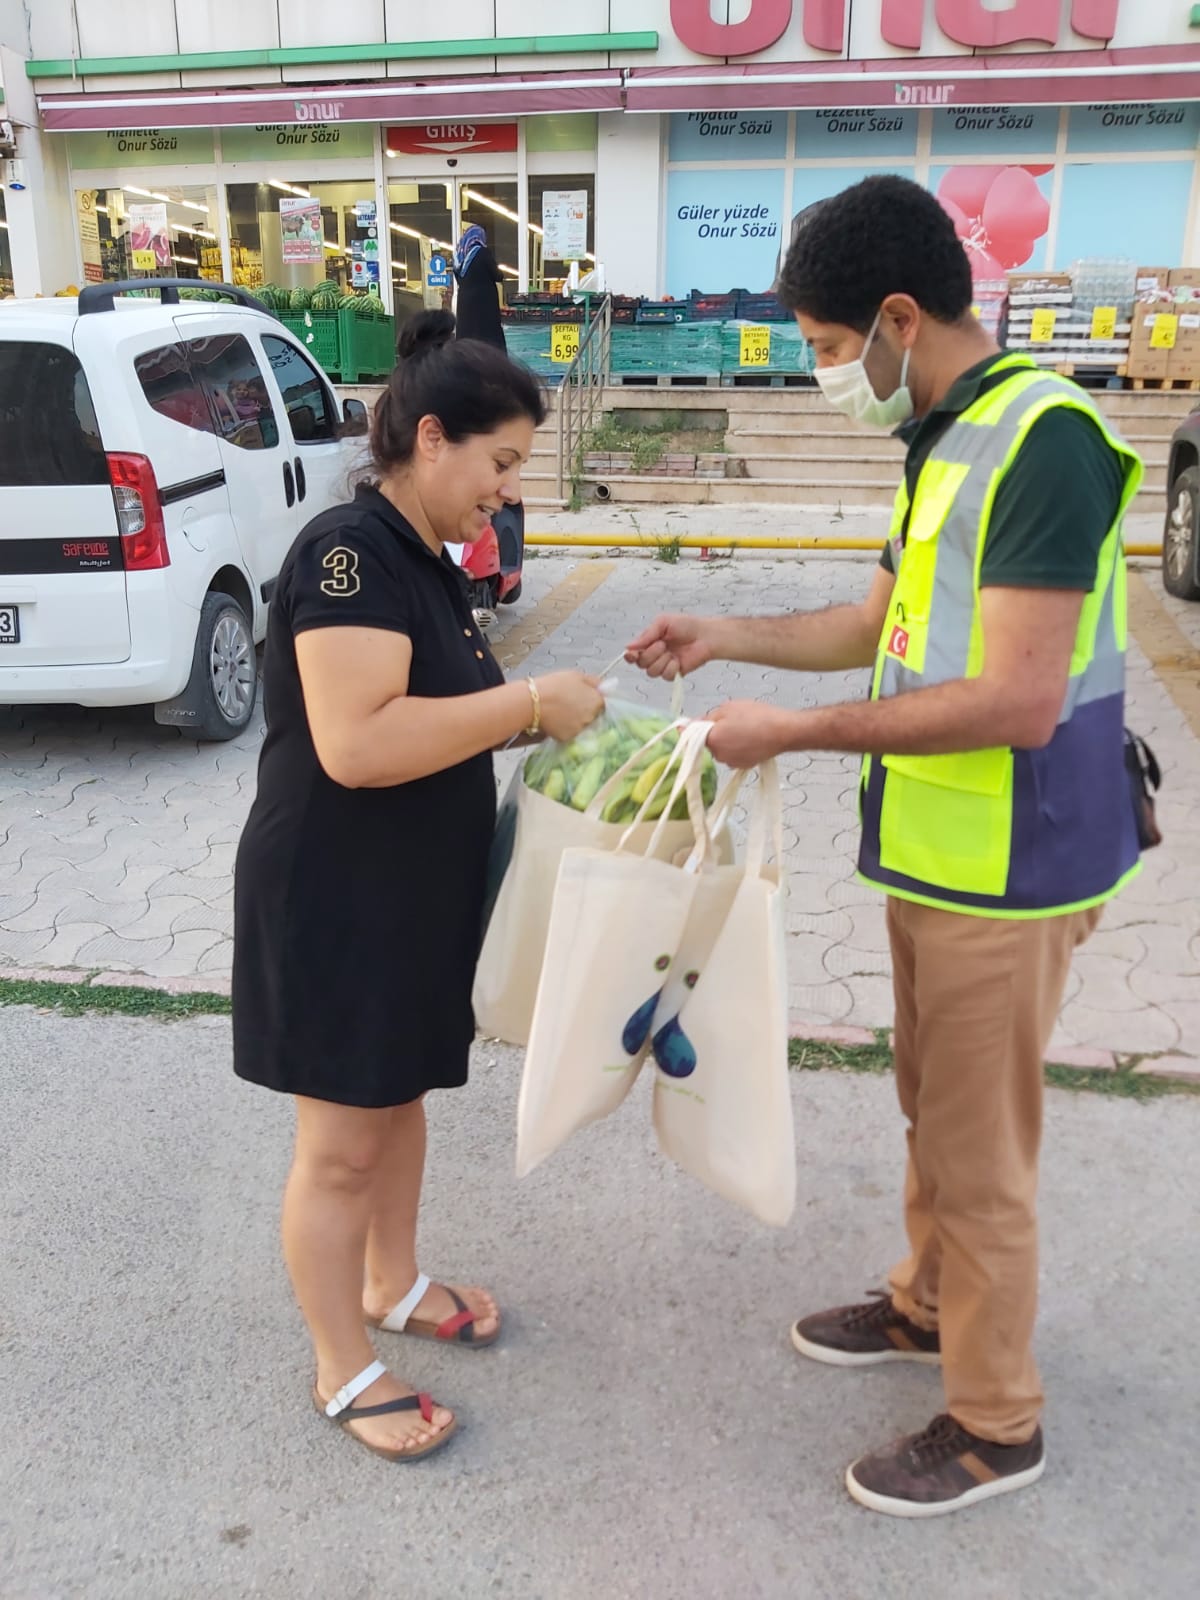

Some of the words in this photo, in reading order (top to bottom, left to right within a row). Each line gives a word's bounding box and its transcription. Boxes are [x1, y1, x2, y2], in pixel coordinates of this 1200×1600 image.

[895, 83, 955, 104] onur
[295, 101, 344, 120] onur
[1102, 112, 1142, 127] Onur
[1146, 108, 1185, 125] Sözü
[699, 122, 736, 136] Onur
[739, 120, 772, 135] Sözü
[827, 119, 864, 133] Onur
[868, 116, 903, 132] Sözü
[955, 116, 994, 130] Onur
[997, 114, 1034, 129] Sözü
[118, 139, 147, 152] Onur
[150, 137, 177, 150] Sözü
[276, 132, 308, 145] Onur
[310, 129, 340, 143] Sözü
[678, 204, 720, 220] Güler
[724, 204, 769, 222] yüzde
[698, 224, 737, 238] Onur
[740, 222, 777, 237] Sözü
[555, 344, 579, 360] 6,99
[743, 347, 769, 363] 1,99
[320, 546, 360, 597] 3
